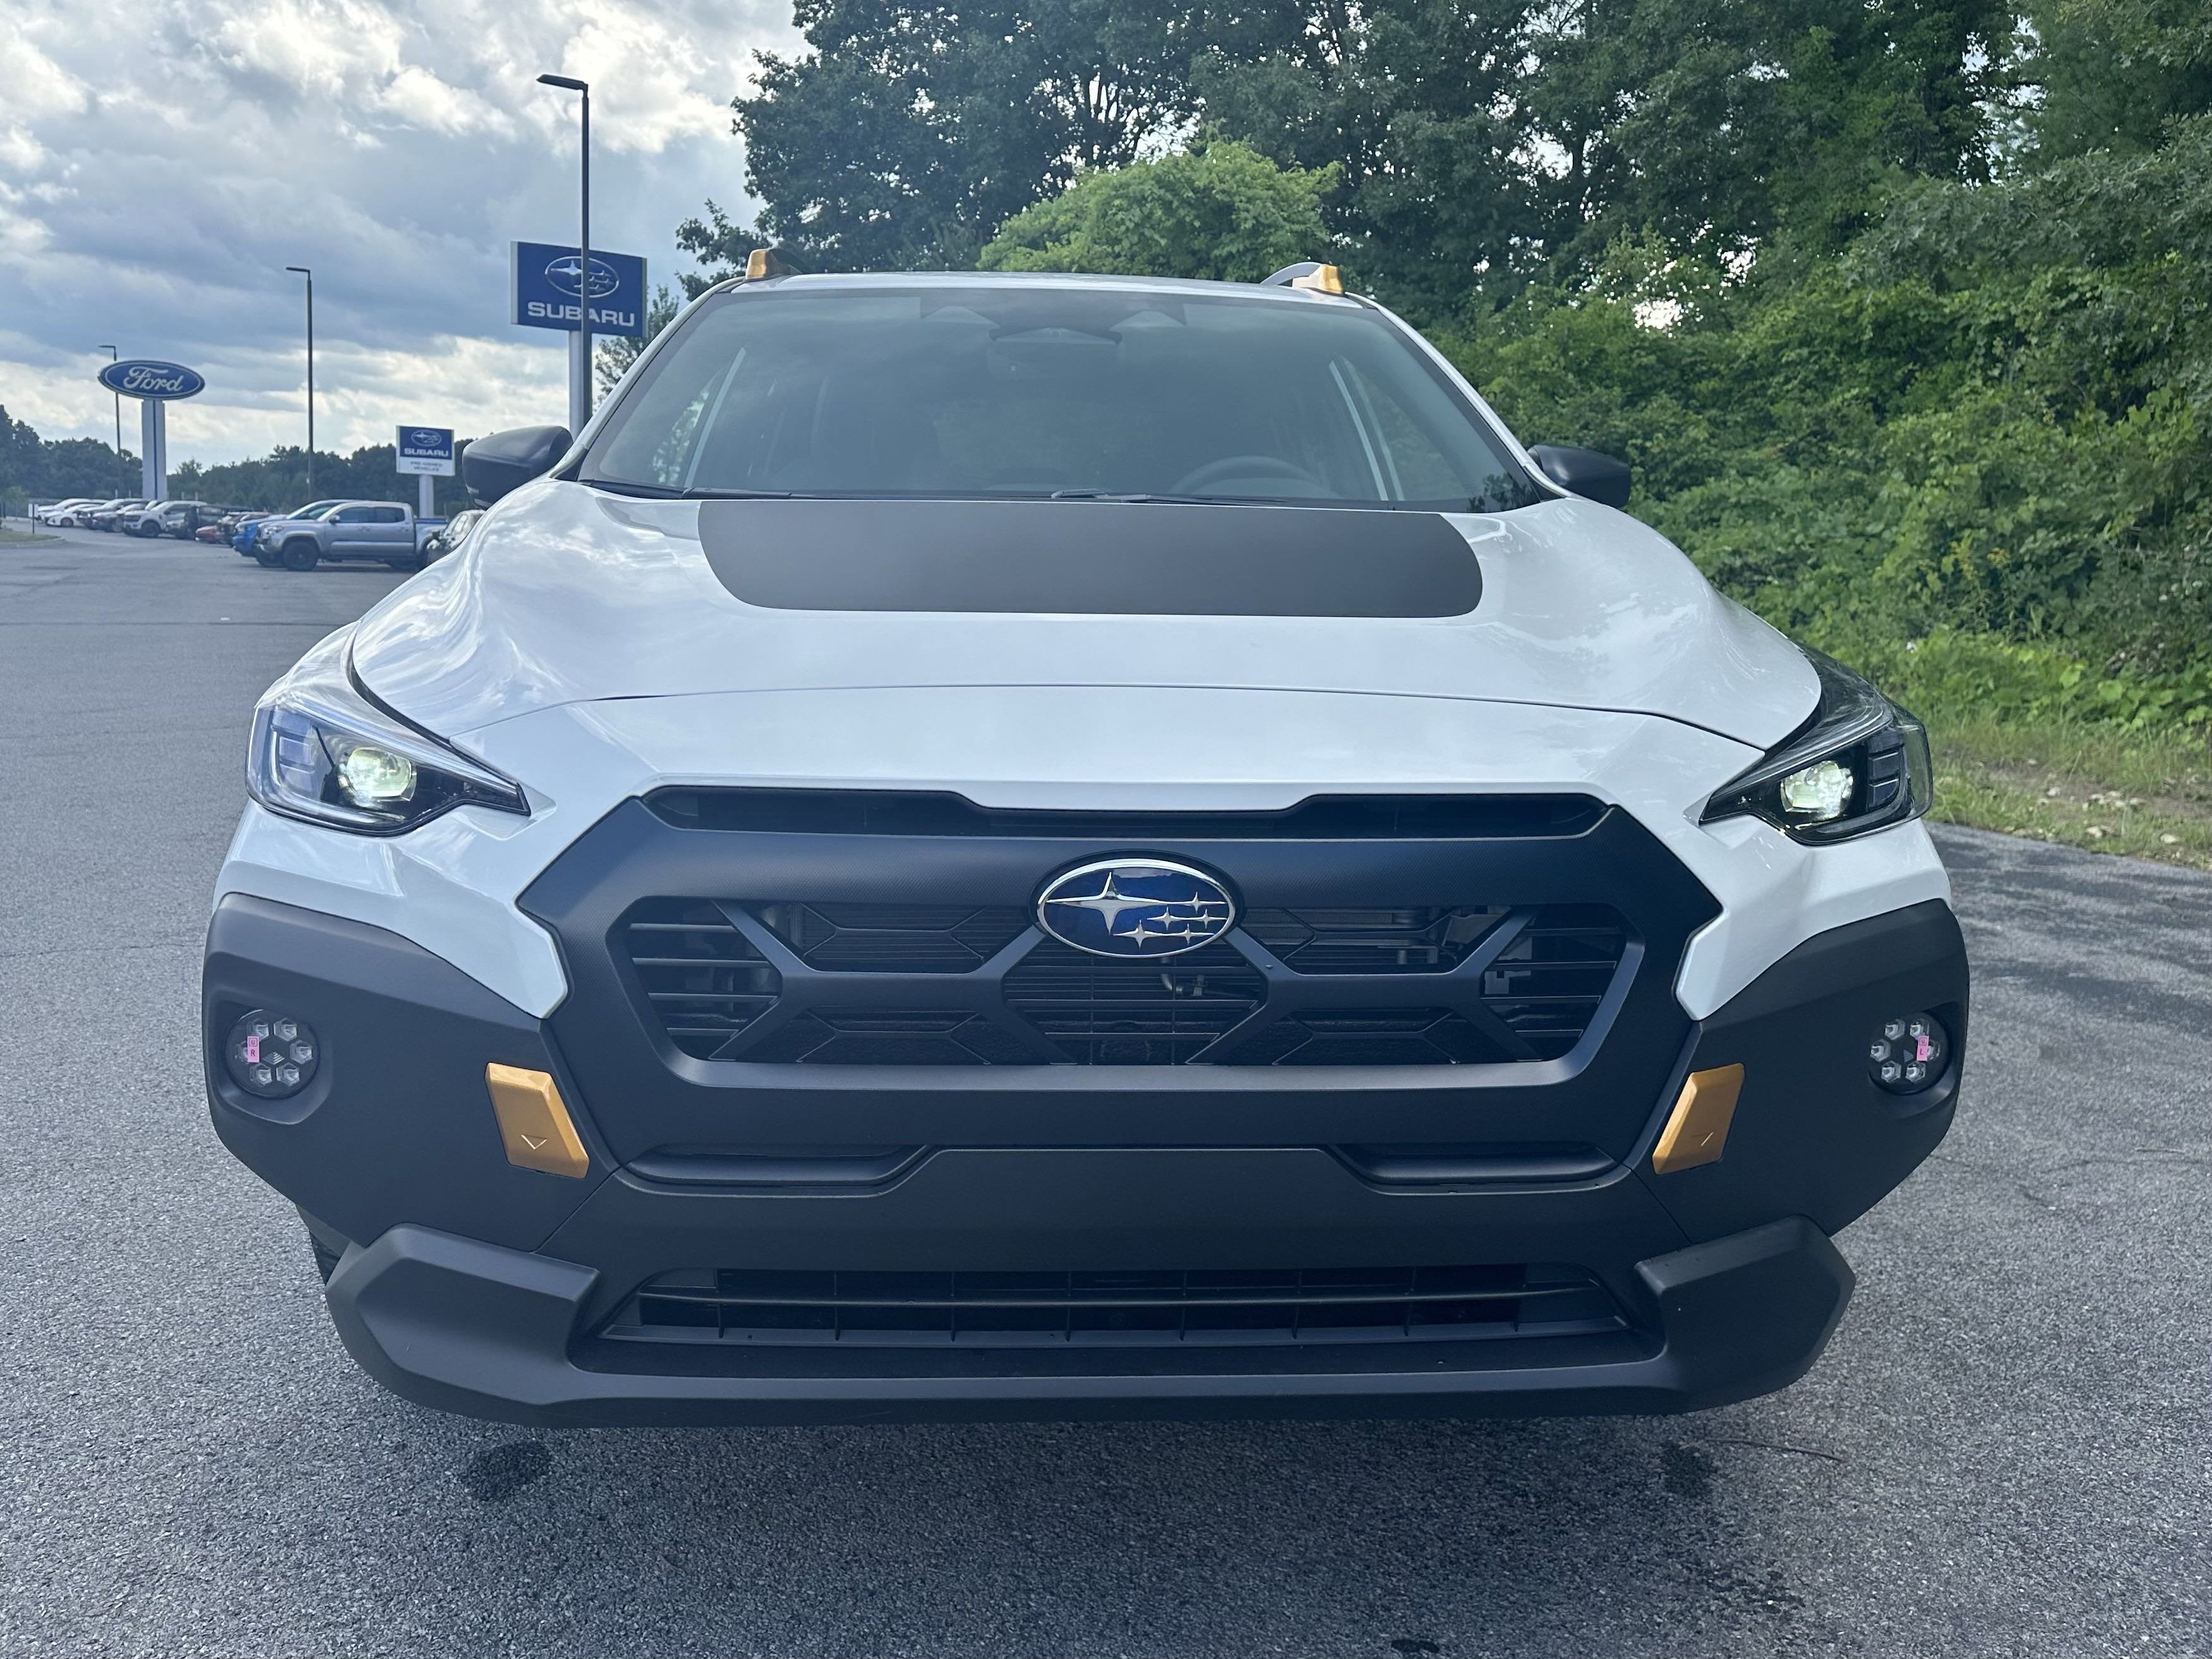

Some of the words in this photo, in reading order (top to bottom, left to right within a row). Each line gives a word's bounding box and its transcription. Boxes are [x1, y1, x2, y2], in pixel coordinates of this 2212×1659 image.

[527, 301, 635, 327] SUBARU
[123, 366, 184, 391] Ford
[404, 447, 448, 457] SUBARU
[250, 1049, 256, 1057] R
